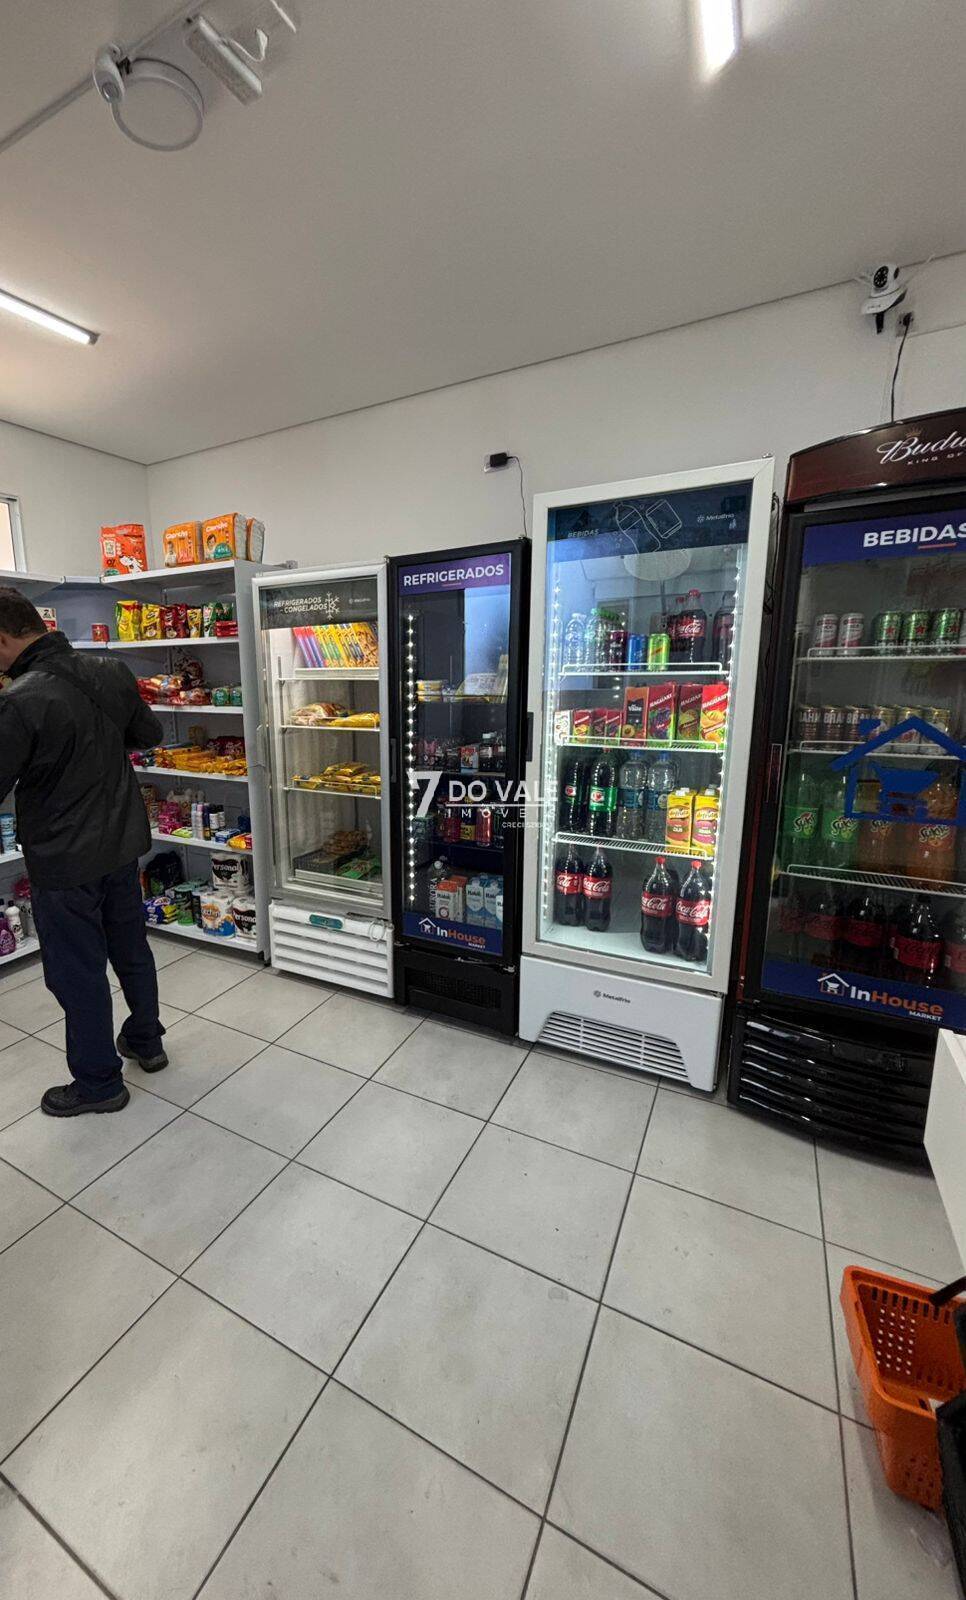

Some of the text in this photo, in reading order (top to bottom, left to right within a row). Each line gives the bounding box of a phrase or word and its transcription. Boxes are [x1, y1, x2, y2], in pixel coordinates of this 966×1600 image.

[907, 456, 938, 466] KING
[567, 528, 600, 538] BEBIDAS
[863, 522, 966, 548] BEBIDAS
[403, 563, 504, 587] REFRIGERADOS
[273, 596, 323, 608] REFRIGERADOS
[284, 602, 328, 614] CONGELADOS
[436, 926, 486, 944] InHouse
[850, 986, 944, 1015] InHouse
[908, 1010, 944, 1022] MARKET
